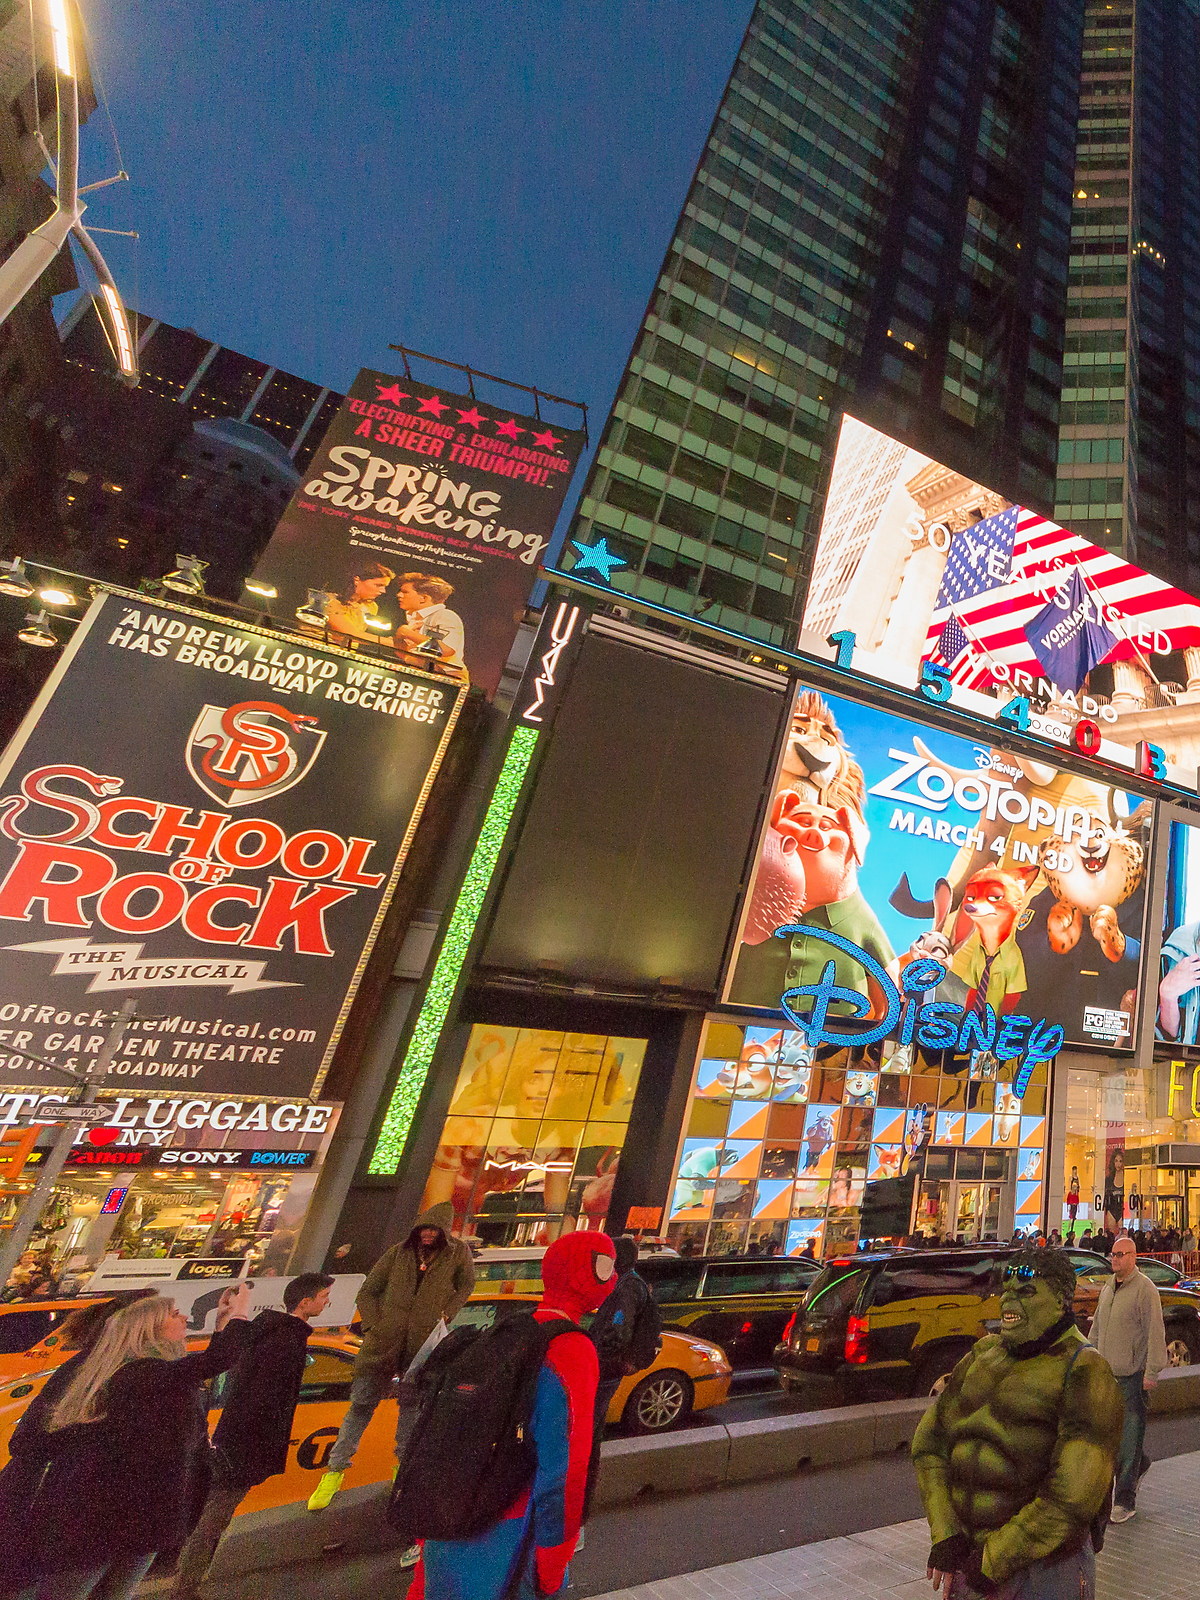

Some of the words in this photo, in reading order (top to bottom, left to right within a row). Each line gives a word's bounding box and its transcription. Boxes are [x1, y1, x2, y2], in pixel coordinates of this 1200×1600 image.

[348, 397, 455, 440] ELECTRIFYING
[470, 433, 572, 473] EXHILARATING
[354, 419, 373, 438] A
[374, 424, 447, 458] SHEER
[449, 443, 551, 487] TRIUMPH!
[322, 445, 502, 518] SPRING
[303, 476, 550, 566] awakening
[901, 511, 950, 553] 50
[1040, 599, 1093, 650] VORNADO
[108, 627, 173, 659] HAS
[175, 643, 323, 696] BROADWAY
[254, 644, 340, 680] LLOYD
[346, 667, 446, 708] WEBBER
[867, 747, 1098, 848] ZOOTOPIA
[0, 764, 387, 890] SCHOOL
[888, 808, 985, 851] MARCH
[989, 836, 1007, 857] 4
[1012, 840, 1039, 866] IN
[1044, 849, 1075, 873] 3D
[168, 858, 236, 886] OF
[0, 838, 358, 957] ROCK
[67, 951, 127, 964] THE
[107, 964, 250, 982] MUSICAL
[1085, 1013, 1104, 1027] PG
[63, 1057, 79, 1073] &
[172, 1040, 285, 1065] THEATRE
[43, 1107, 67, 1116] ONE
[80, 1108, 107, 1117] WAY
[104, 1097, 333, 1135] LUGGAGE
[65, 1149, 143, 1164] Canon
[159, 1150, 240, 1165] SONY
[249, 1151, 310, 1165] BOWER
[72, 1127, 90, 1146] I
[115, 1128, 175, 1147] NY
[1128, 1193, 1147, 1212] ON.
